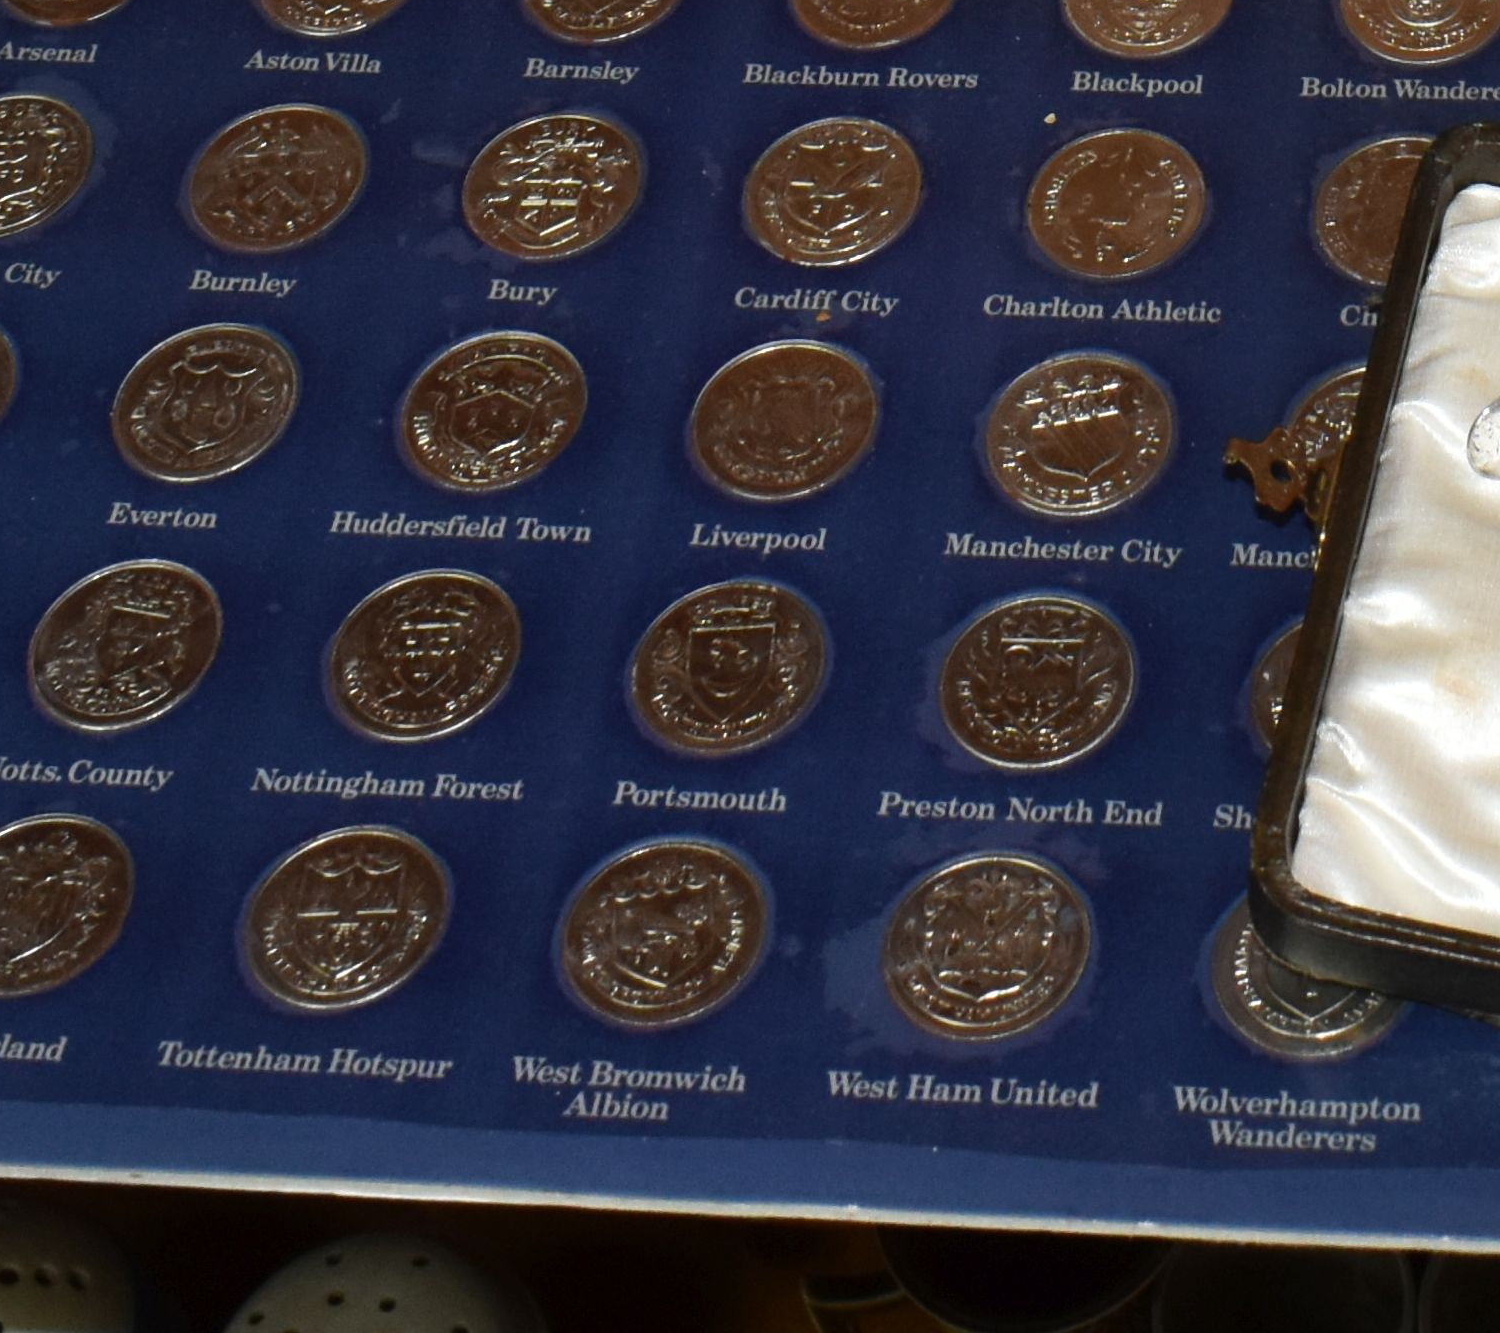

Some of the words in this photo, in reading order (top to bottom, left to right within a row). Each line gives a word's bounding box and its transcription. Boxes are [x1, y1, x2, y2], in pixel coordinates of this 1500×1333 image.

[244, 50, 319, 71] Aston
[326, 53, 380, 73] Villa
[524, 58, 639, 84] Barnsley
[743, 64, 879, 86] Blackburn
[888, 68, 978, 88] Rovers
[1072, 71, 1202, 97] Blackpool
[1301, 77, 1386, 98] Bolton
[5, 263, 61, 289] City
[189, 270, 296, 297] Burnley
[488, 279, 557, 305] Bury
[735, 287, 837, 310] Cardiff
[841, 291, 898, 316] City
[984, 295, 1103, 318] Charlton
[1112, 299, 1221, 322] Athletic
[107, 502, 217, 528] Everton
[330, 511, 506, 538] Huddersfield
[517, 518, 591, 542] Town
[690, 524, 826, 554] Liverpool
[945, 533, 1114, 560] Manchester
[1121, 539, 1181, 568] City
[68, 760, 173, 791] County
[251, 768, 424, 798] Nottingham
[432, 774, 522, 800] Forest
[613, 781, 786, 811] Portsmouth
[878, 792, 994, 820] Preston
[1006, 797, 1092, 822] North
[1103, 800, 1162, 825] End
[159, 1041, 320, 1072] Tottenham
[327, 1048, 453, 1082] Hotspur
[514, 1056, 580, 1084] West
[588, 1061, 745, 1091] Bromwich
[828, 1071, 896, 1099] West
[907, 1075, 981, 1102] Ham
[991, 1078, 1098, 1107] United
[564, 1092, 668, 1120] Albion
[1174, 1086, 1420, 1125] Wolverhampton
[1210, 1120, 1375, 1150] Wanderers
